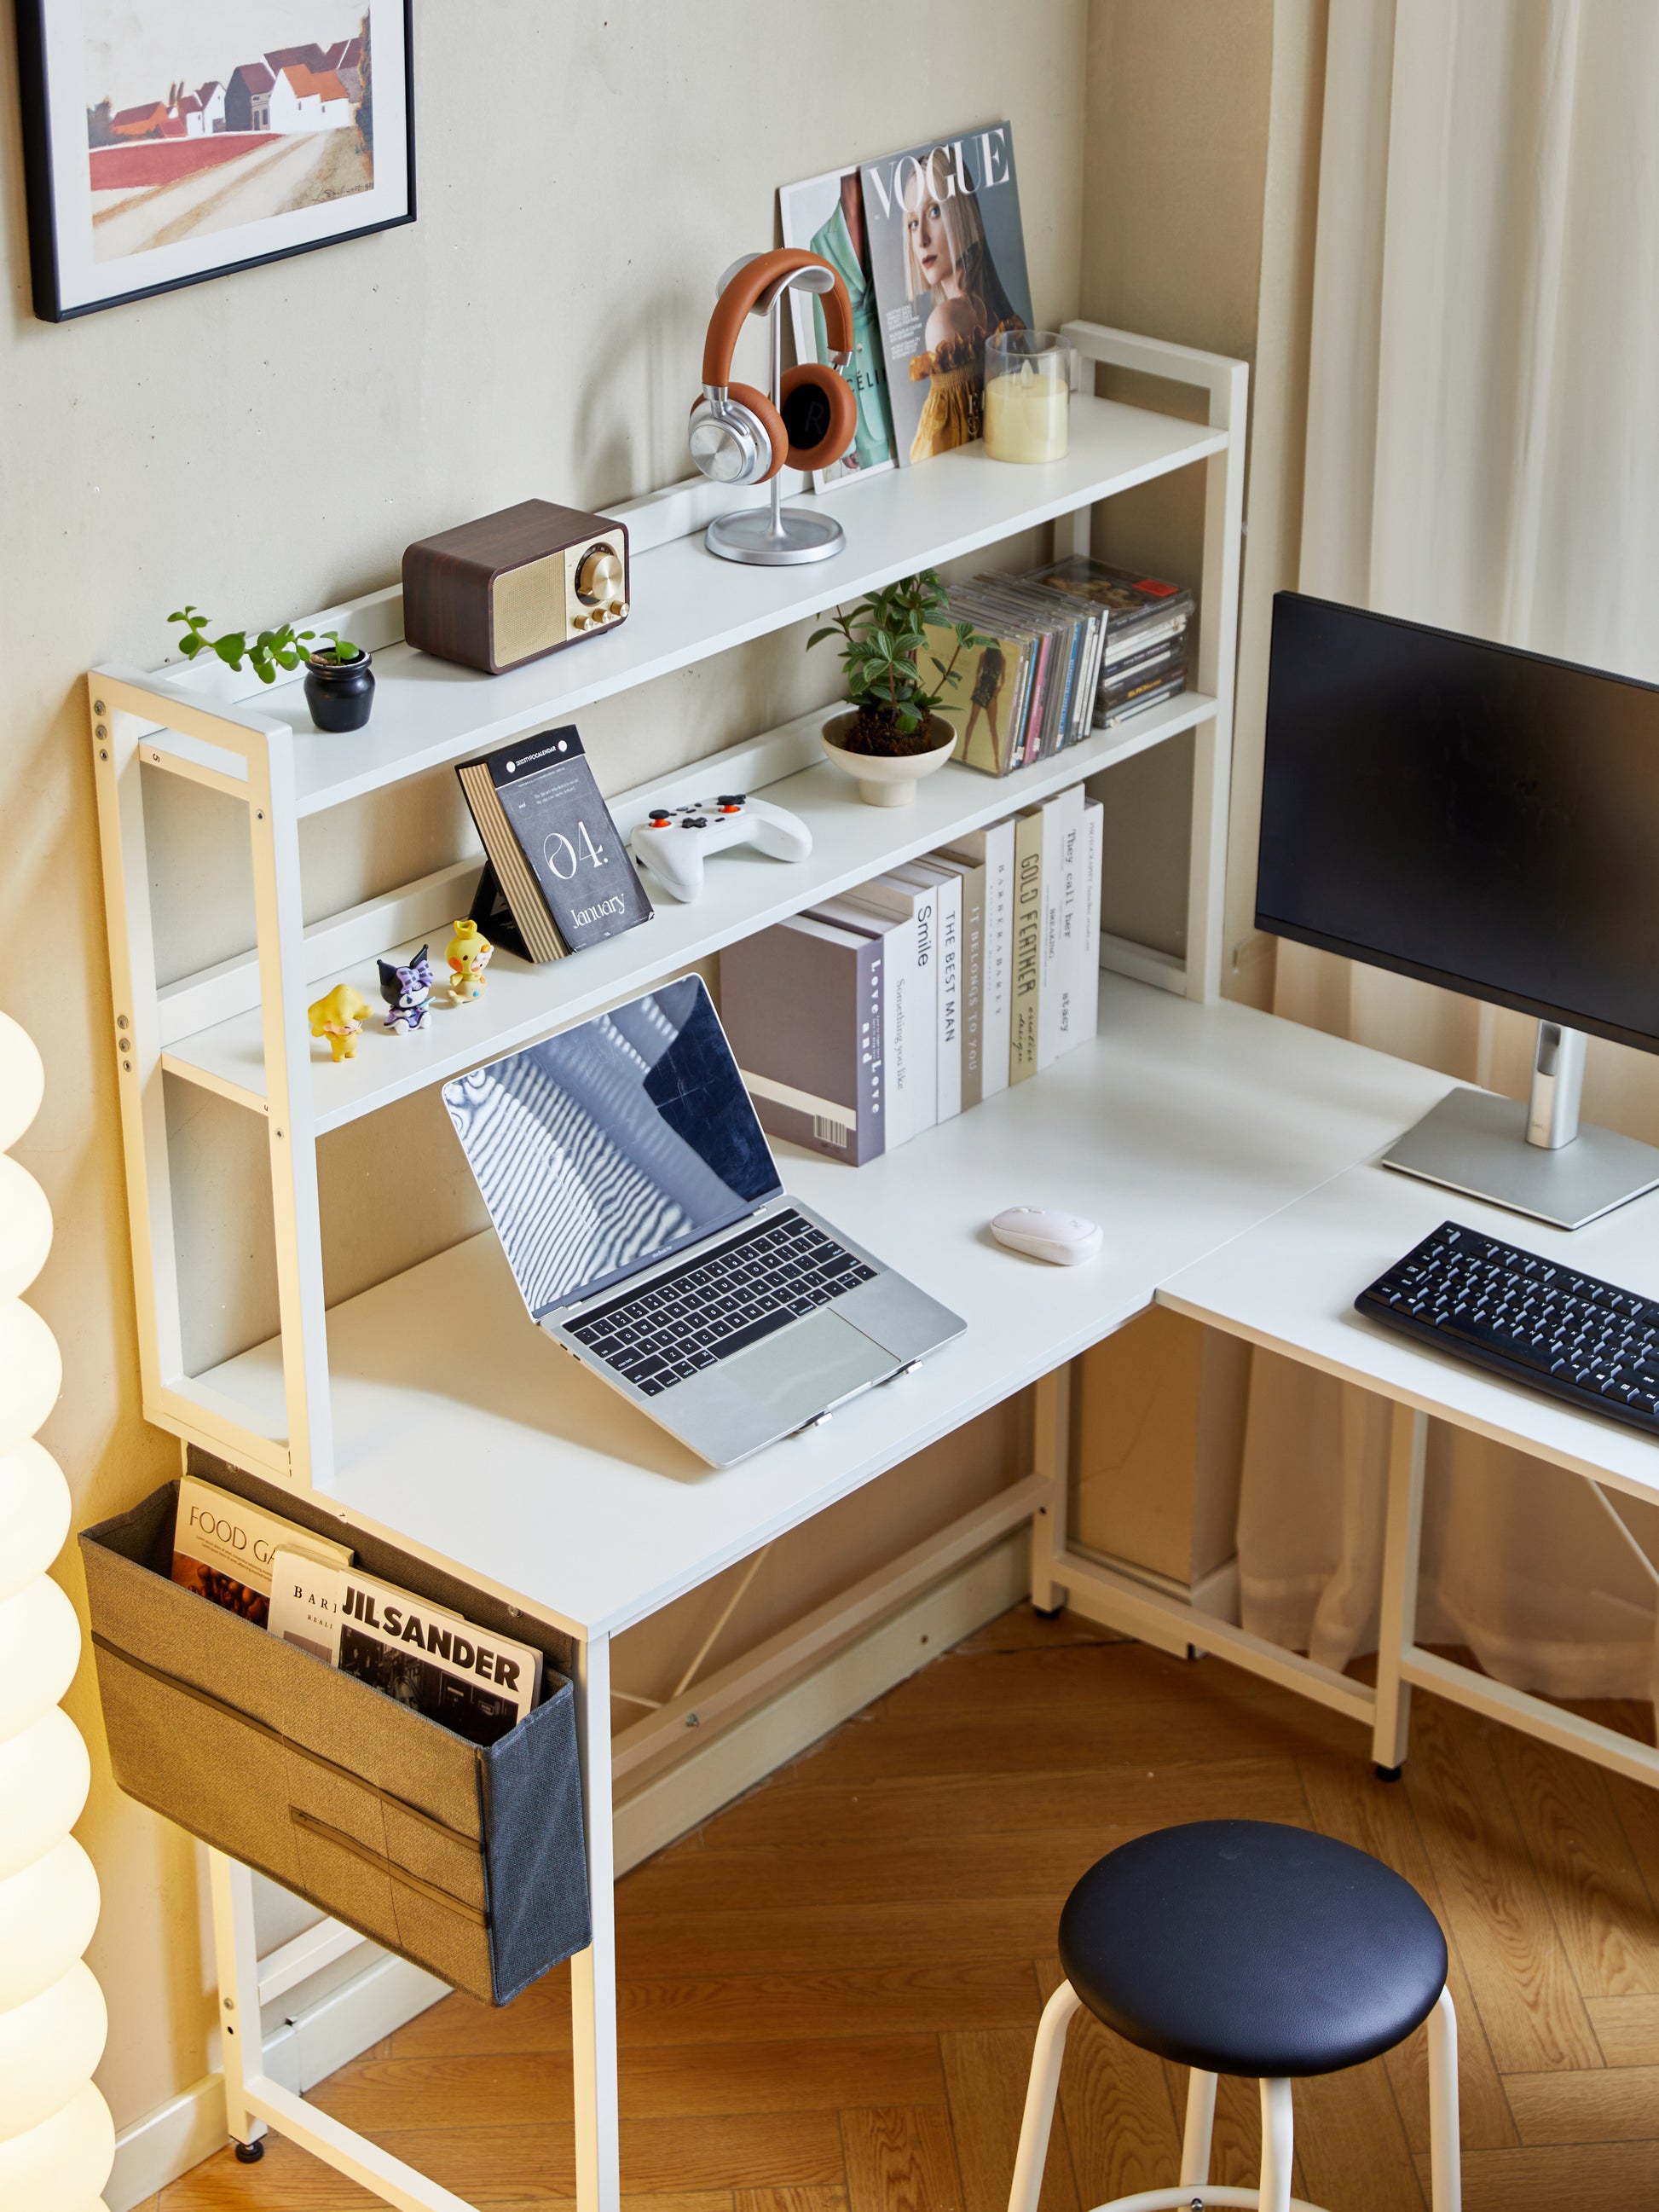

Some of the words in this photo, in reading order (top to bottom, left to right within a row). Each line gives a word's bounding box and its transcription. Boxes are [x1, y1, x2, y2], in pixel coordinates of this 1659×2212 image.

[866, 128, 1009, 219] VOGUE
[1065, 828, 1077, 863] They
[1020, 853, 1039, 904] GOLD
[1065, 872, 1075, 904] call
[570, 894, 625, 929] January
[945, 910, 956, 947] THE
[969, 906, 980, 924] IT
[1064, 912, 1072, 939] her
[917, 905, 932, 967] Smile
[1017, 909, 1038, 997] FEATHER
[870, 958, 882, 1014] Love
[945, 952, 956, 993] BEST
[968, 931, 980, 1006] BELONGS
[895, 978, 905, 1045] Something
[945, 1000, 955, 1043] MAN
[968, 1012, 978, 1034] TO
[1060, 992, 1070, 1032] stacy
[862, 1022, 873, 1064] and
[895, 1045, 905, 1072] you
[870, 1059, 882, 1115] Love
[189, 1505, 247, 1550] FOOD
